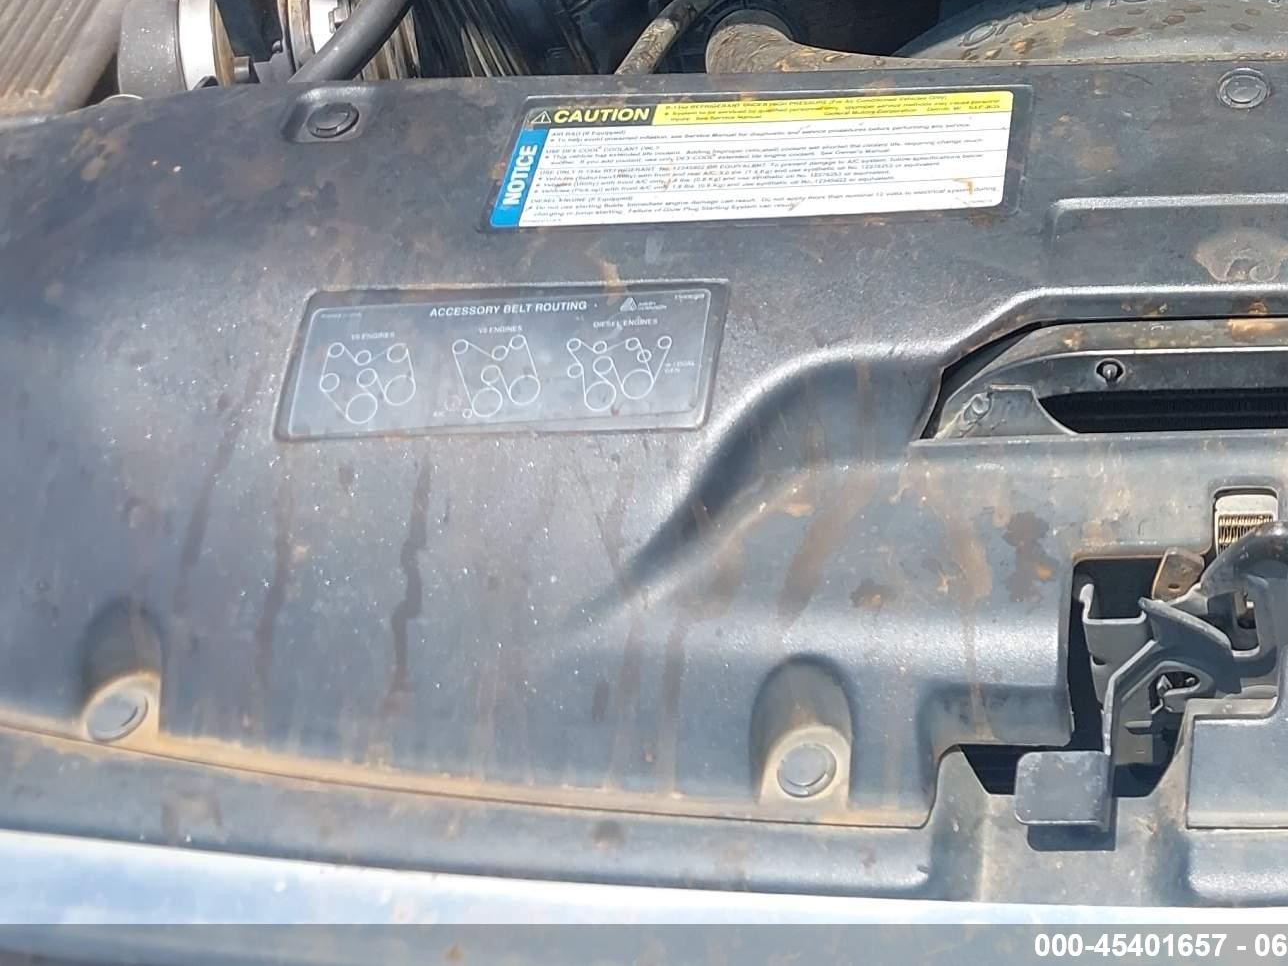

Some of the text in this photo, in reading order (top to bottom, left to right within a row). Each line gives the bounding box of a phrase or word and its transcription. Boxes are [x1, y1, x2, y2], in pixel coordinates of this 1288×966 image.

[553, 108, 650, 123] CAUTION
[502, 144, 538, 206] NOTICE
[430, 301, 588, 317] ACCESSORY BELT ROUTING
